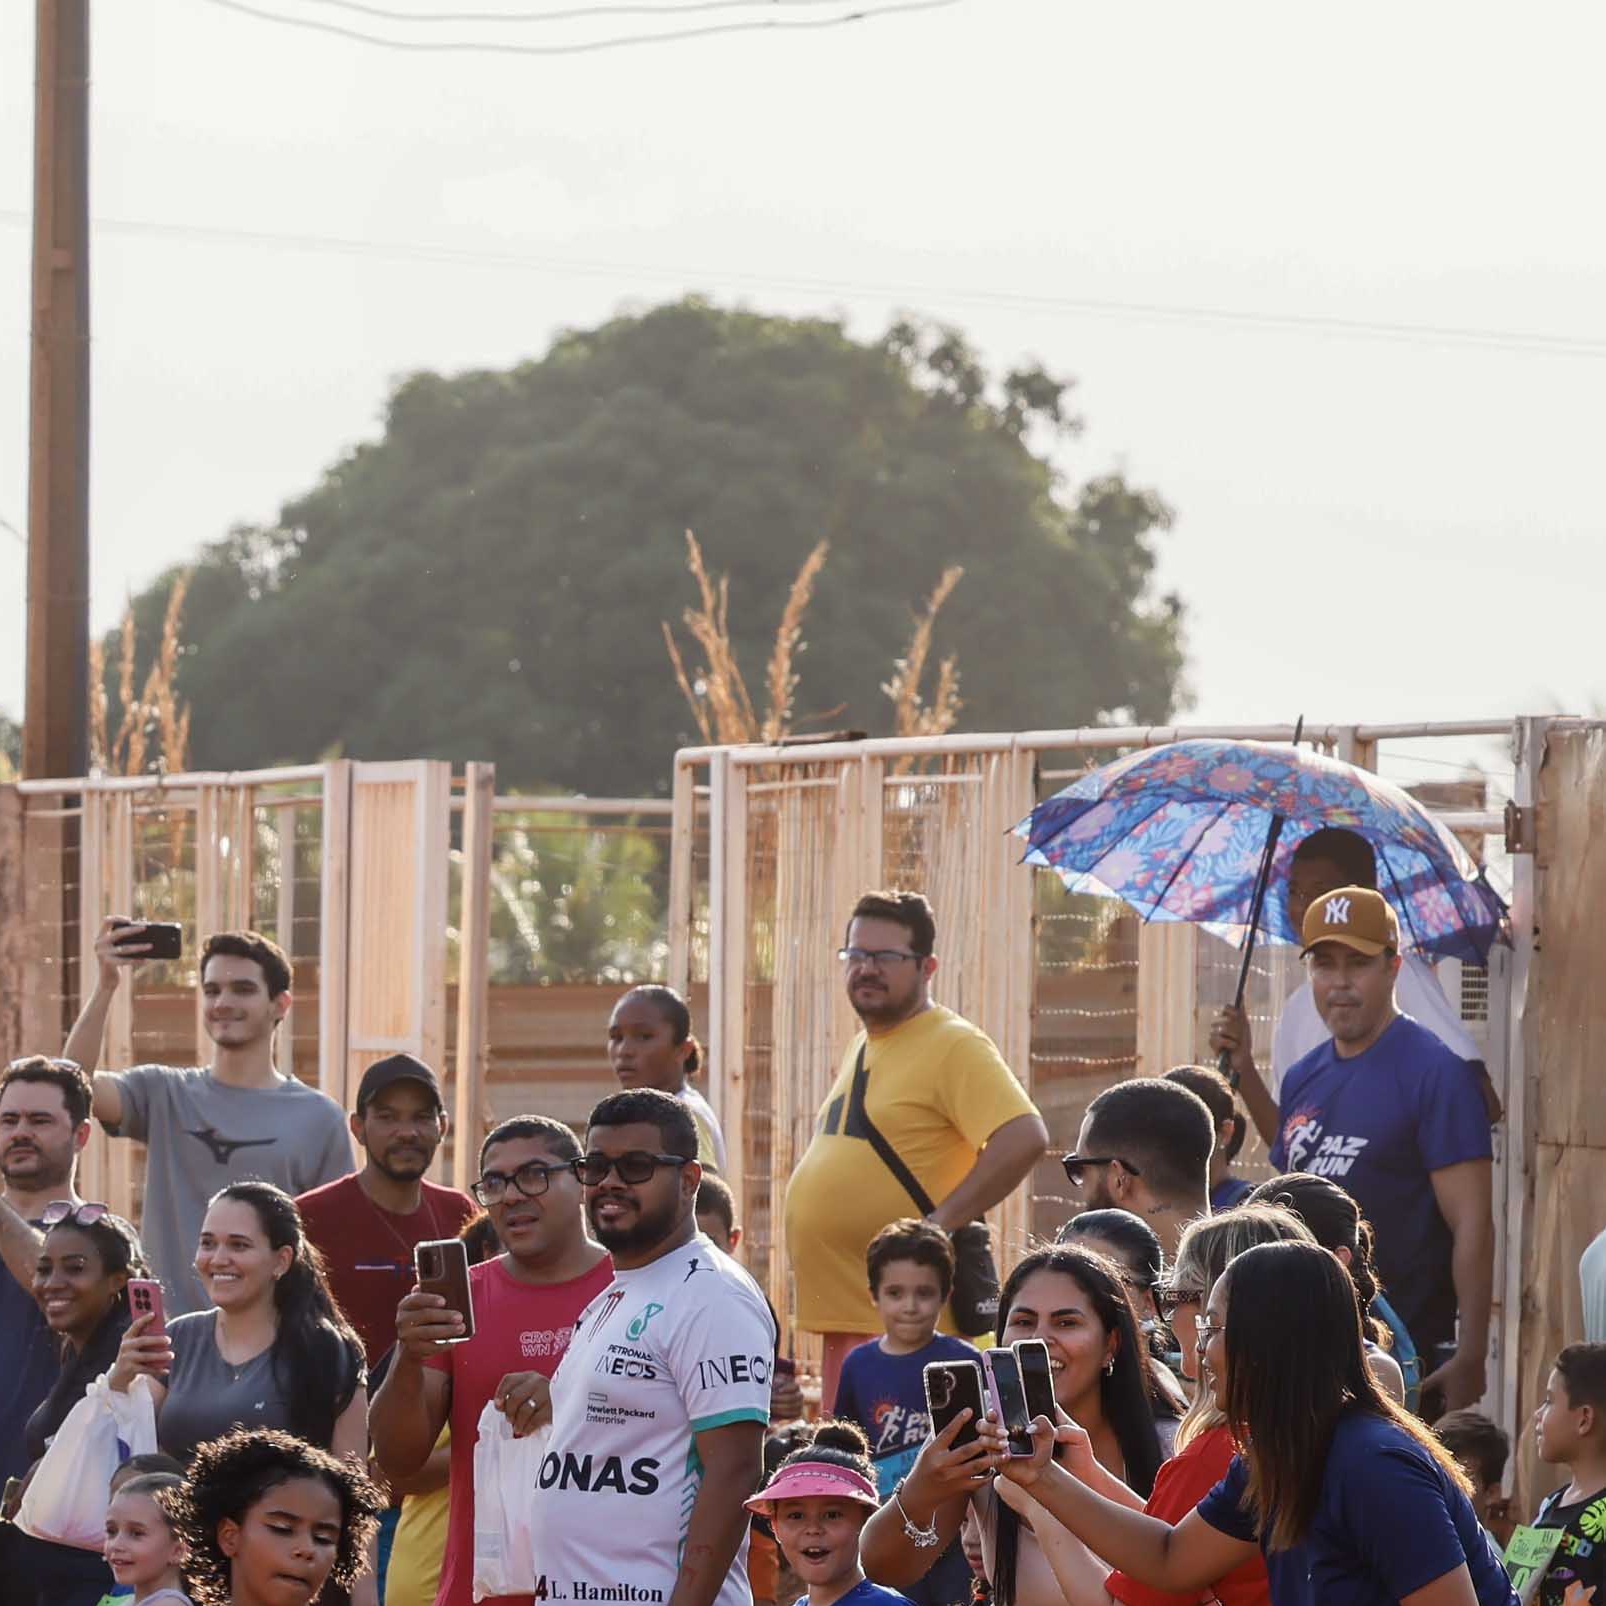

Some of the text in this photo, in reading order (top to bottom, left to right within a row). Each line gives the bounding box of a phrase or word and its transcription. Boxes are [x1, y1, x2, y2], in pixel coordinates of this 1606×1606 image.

[1315, 1135, 1369, 1157] PAZ
[607, 1344, 654, 1363] PETRONAS
[595, 1355, 657, 1381] INEOS
[586, 1403, 656, 1420] Hewlett Packard
[586, 1413, 627, 1426] Enterprise
[535, 1450, 661, 1496] ONAS
[535, 1574, 665, 1603] 4 L. Hamilton
